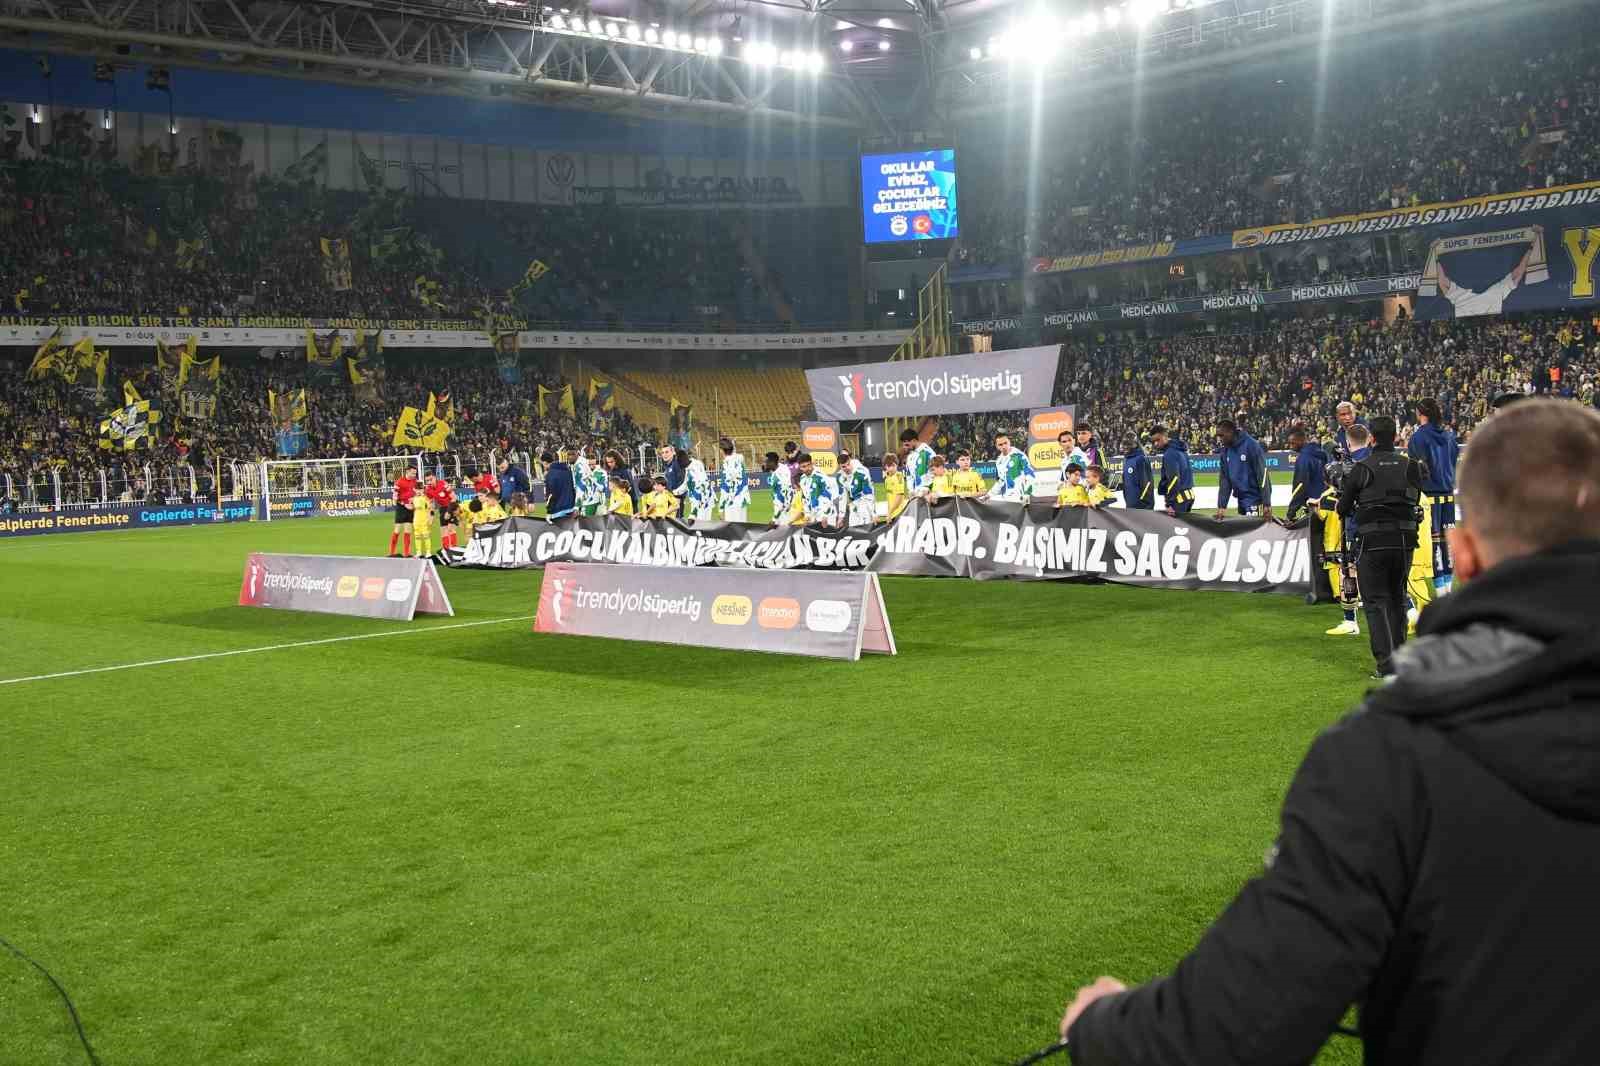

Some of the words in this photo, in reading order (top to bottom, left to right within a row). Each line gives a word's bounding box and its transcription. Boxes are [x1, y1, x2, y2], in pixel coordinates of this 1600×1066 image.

[881, 160, 934, 174] OKULLAR
[1291, 283, 1352, 301] MEDICANA
[1203, 294, 1257, 311] MEDICANA
[1121, 303, 1171, 318] MEDICANA
[168, 317, 193, 327] TEK
[198, 317, 234, 328] SANA
[962, 319, 1016, 333] MEDICANA
[1044, 311, 1091, 326] MEDICANA
[866, 372, 948, 402] trendyol
[815, 456, 833, 468] ESİNE
[56, 513, 129, 527] Fenerbahçe
[141, 509, 194, 523] Ceplerde
[993, 522, 1107, 577] BAŞIMIZ
[1114, 527, 1190, 580] SAĞ
[263, 571, 302, 589] trendyol
[576, 586, 644, 615] trendyol
